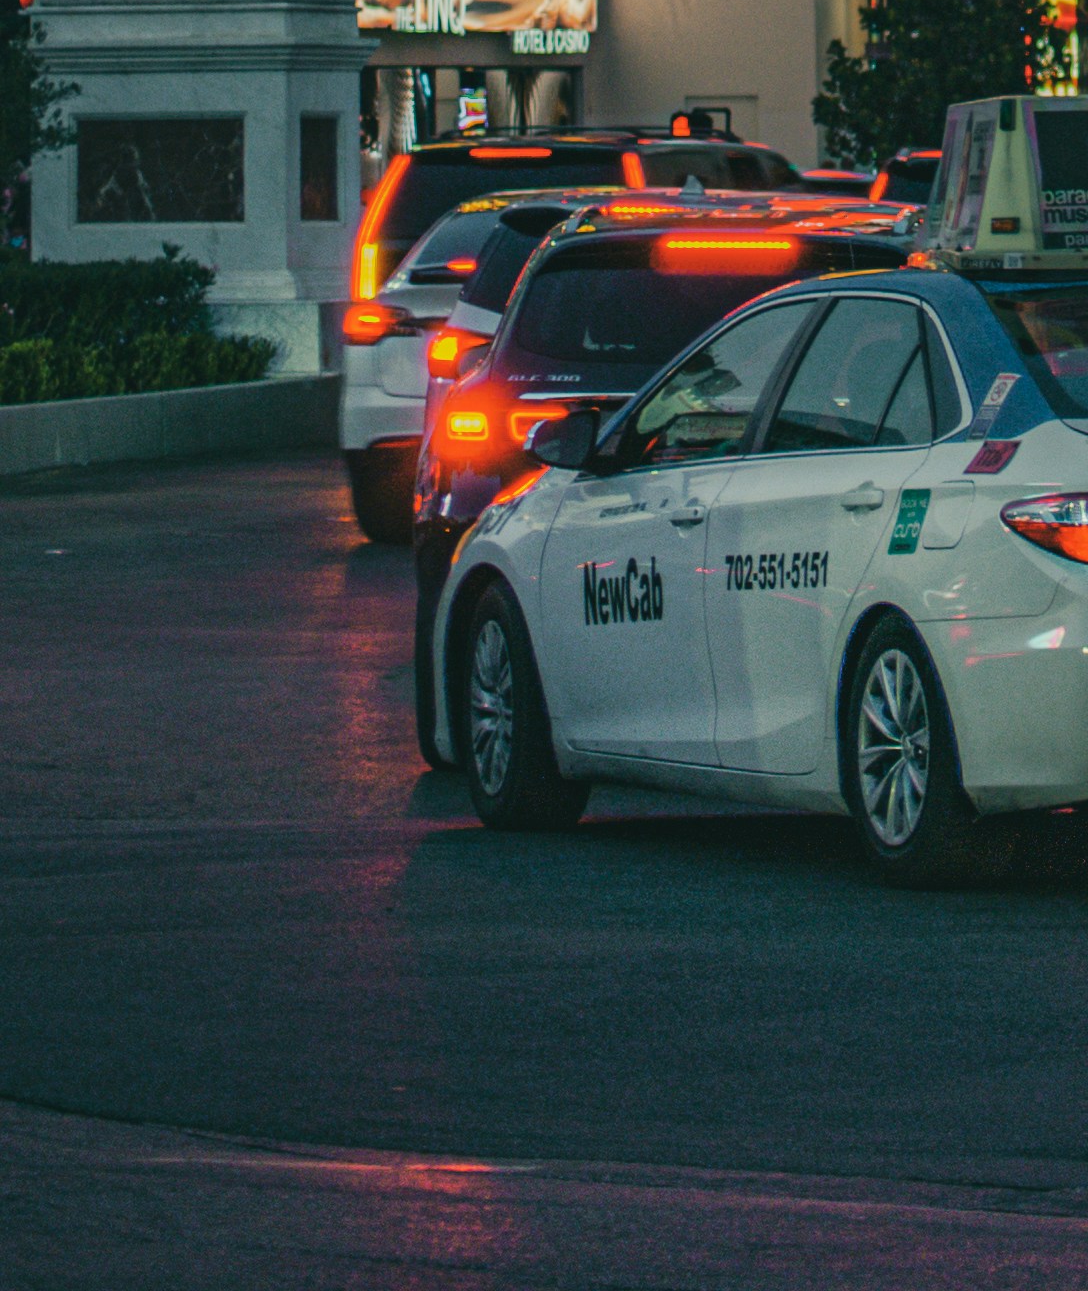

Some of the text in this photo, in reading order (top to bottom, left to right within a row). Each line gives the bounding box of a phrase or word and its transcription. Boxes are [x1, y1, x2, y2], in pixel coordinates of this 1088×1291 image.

[396, 5, 415, 32] THE
[513, 30, 545, 55] HOTEL
[554, 29, 590, 55] CASINO
[544, 374, 581, 382] 300
[725, 550, 829, 593] 702-551-5151
[583, 555, 664, 626] NewCab
